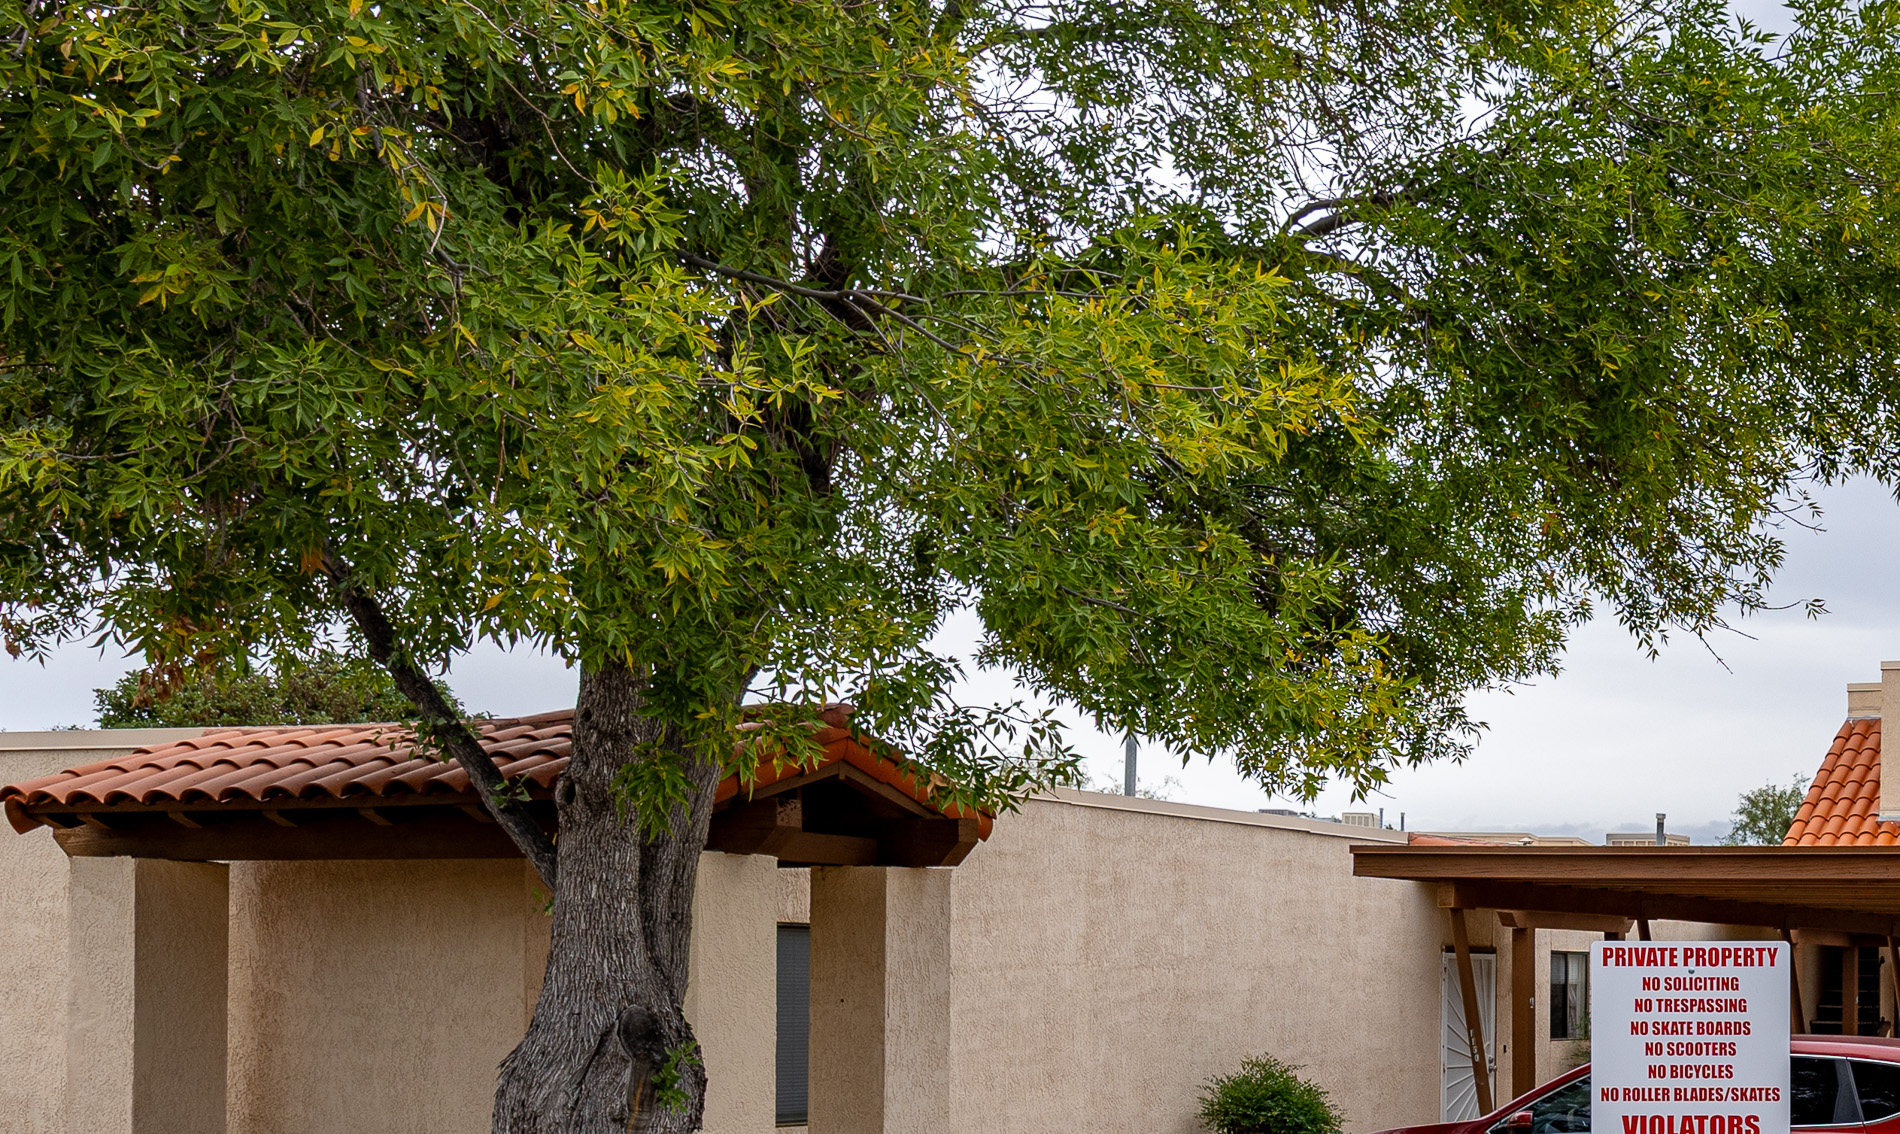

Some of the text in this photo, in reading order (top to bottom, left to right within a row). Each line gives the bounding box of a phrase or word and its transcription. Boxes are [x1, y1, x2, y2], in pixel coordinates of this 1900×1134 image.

[1602, 947, 1779, 967] PRIVATE PROPERTY
[1642, 976, 1740, 991] NO SOLICITING
[1634, 998, 1748, 1013] NO TRESPASSING
[1630, 1021, 1751, 1035] NO SKATE BOARDS
[1645, 1041, 1737, 1056] NO SCOOTERS
[1648, 1064, 1734, 1079] NO BICYCLES
[1600, 1087, 1780, 1102] NO ROLLER BLADES/SKATES
